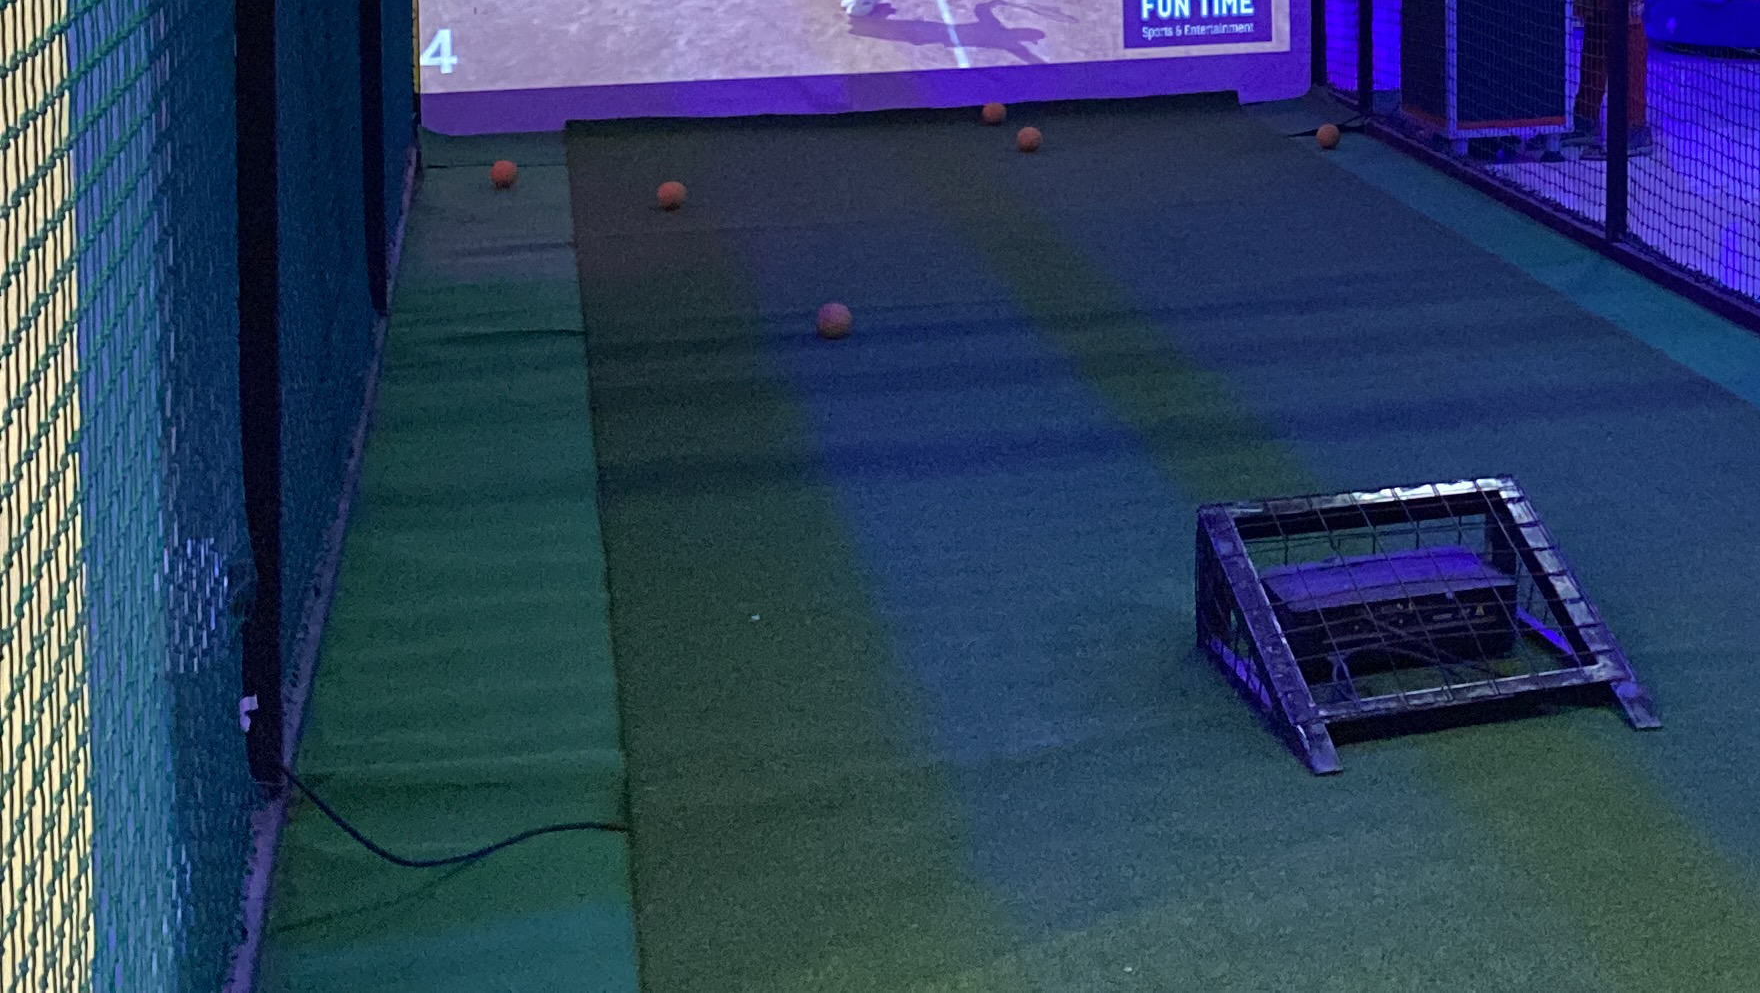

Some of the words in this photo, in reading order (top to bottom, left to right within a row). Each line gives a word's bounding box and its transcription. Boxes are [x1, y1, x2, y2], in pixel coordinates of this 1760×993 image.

[1142, 26, 1173, 40] Sports
[1175, 25, 1183, 36] &
[1184, 22, 1254, 35] Entertainment
[420, 28, 458, 74] 4
